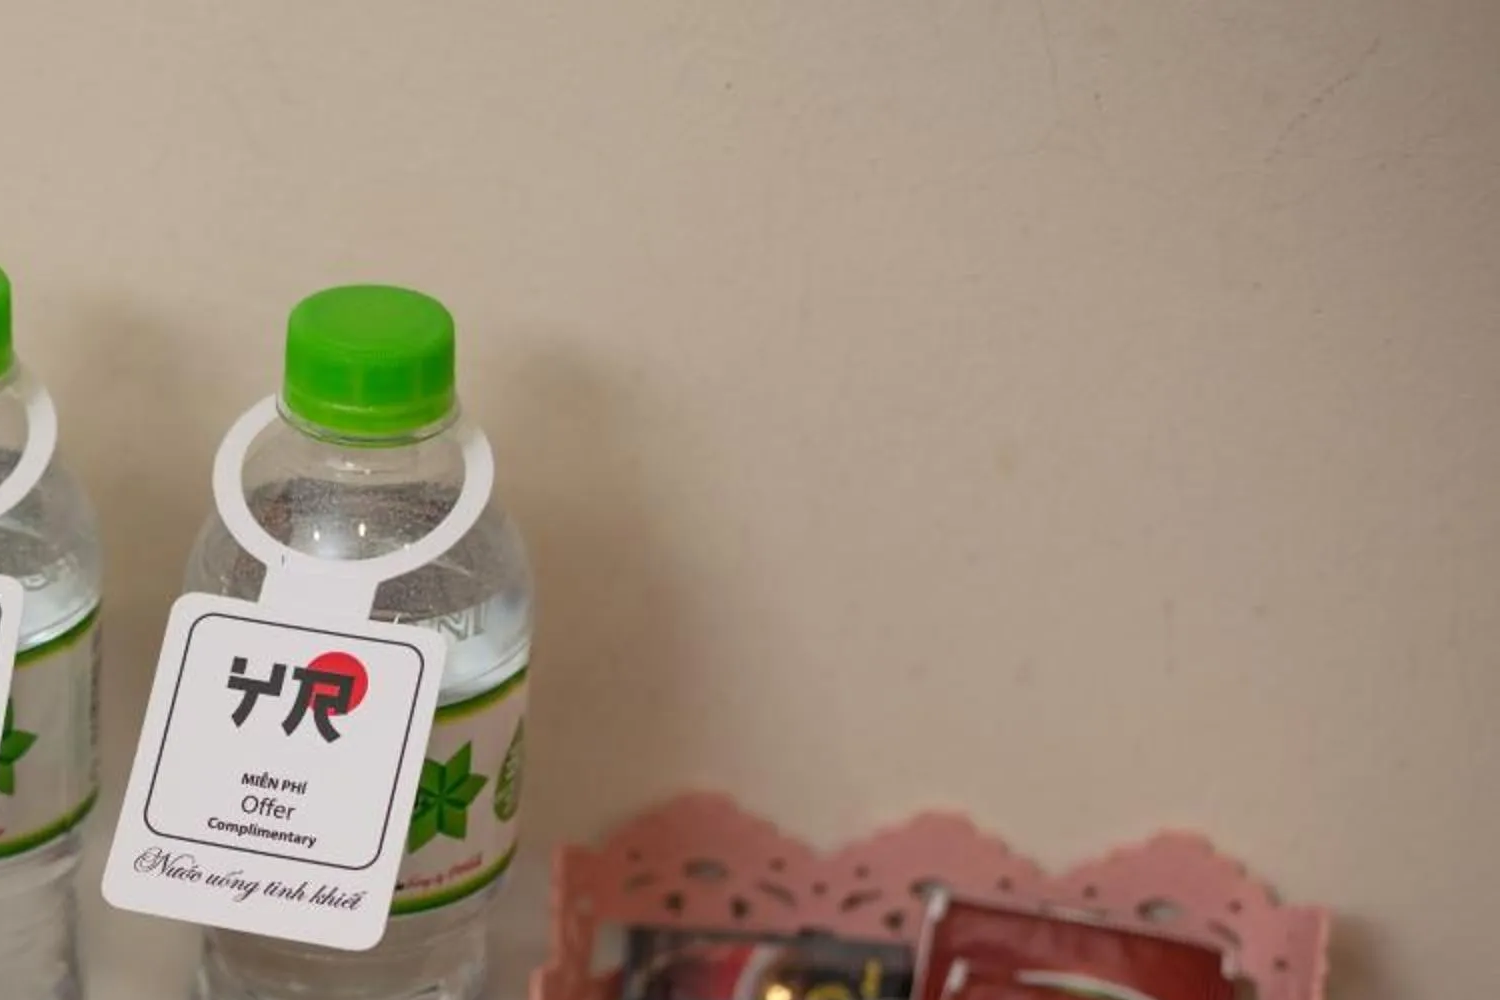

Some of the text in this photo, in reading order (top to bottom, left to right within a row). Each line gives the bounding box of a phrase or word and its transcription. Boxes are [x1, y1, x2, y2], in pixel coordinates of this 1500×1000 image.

[281, 778, 308, 795] PHÍ
[241, 795, 296, 820] Offer
[207, 817, 317, 848] Complimentary
